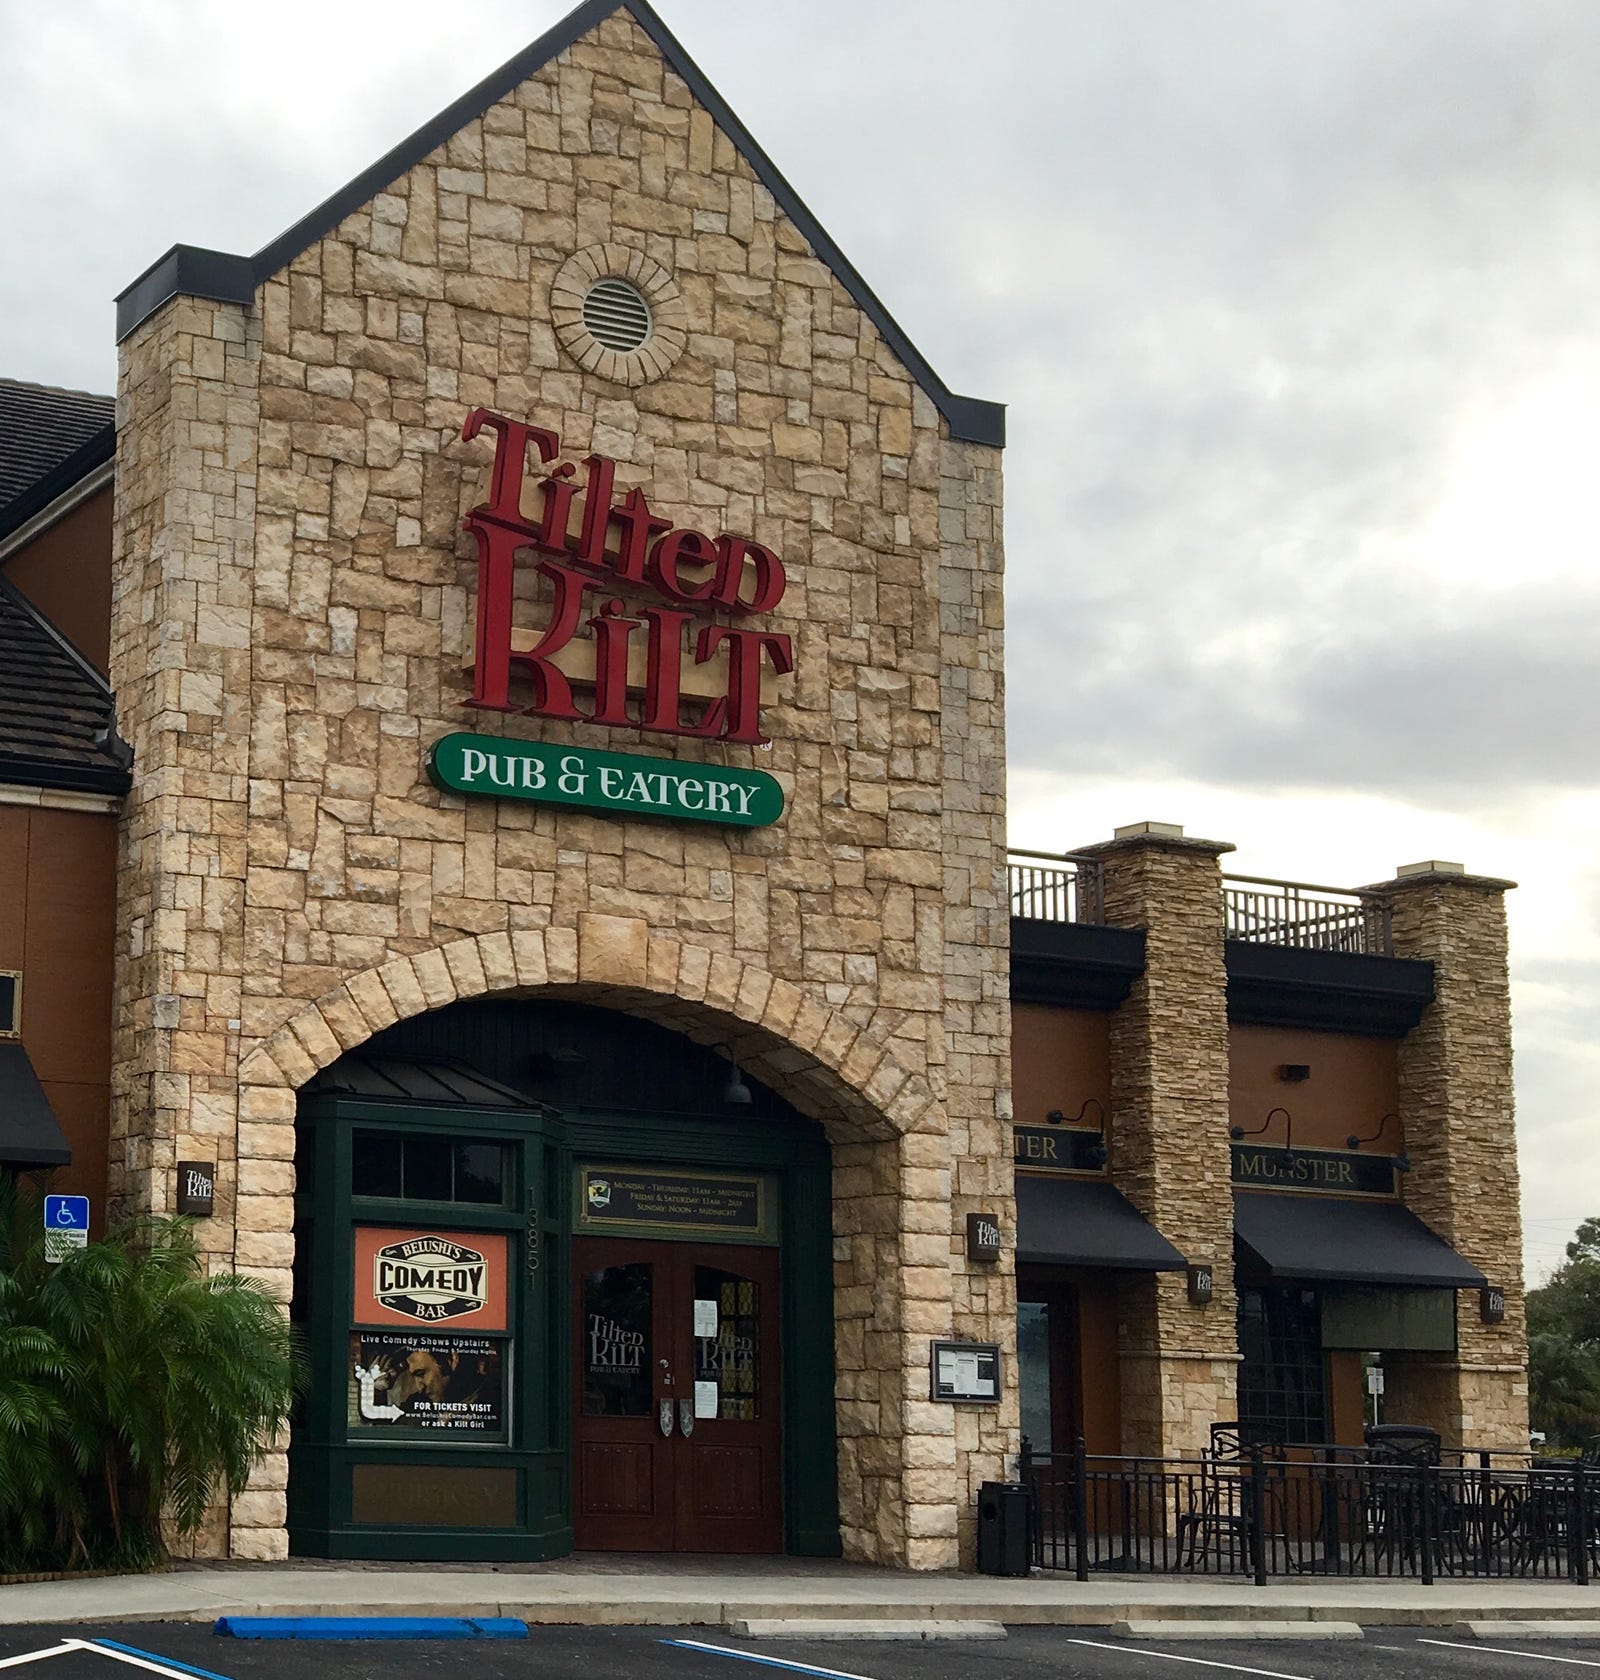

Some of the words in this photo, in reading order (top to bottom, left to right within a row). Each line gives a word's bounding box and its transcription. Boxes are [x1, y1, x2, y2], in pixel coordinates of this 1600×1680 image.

[460, 748, 547, 789] PUB
[557, 756, 589, 795] &
[401, 1240, 462, 1259] BELUSHI'S
[380, 1262, 483, 1296] COMEDY
[414, 1303, 449, 1318] BAR
[360, 1334, 380, 1343] Live
[382, 1335, 418, 1346] Comedy
[420, 1336, 450, 1346] Shows
[452, 1338, 490, 1348] Upstairs
[414, 1401, 431, 1410] FOR
[433, 1402, 468, 1412] TICKETS
[470, 1403, 492, 1412] VISIT
[470, 1421, 485, 1429] Girl
